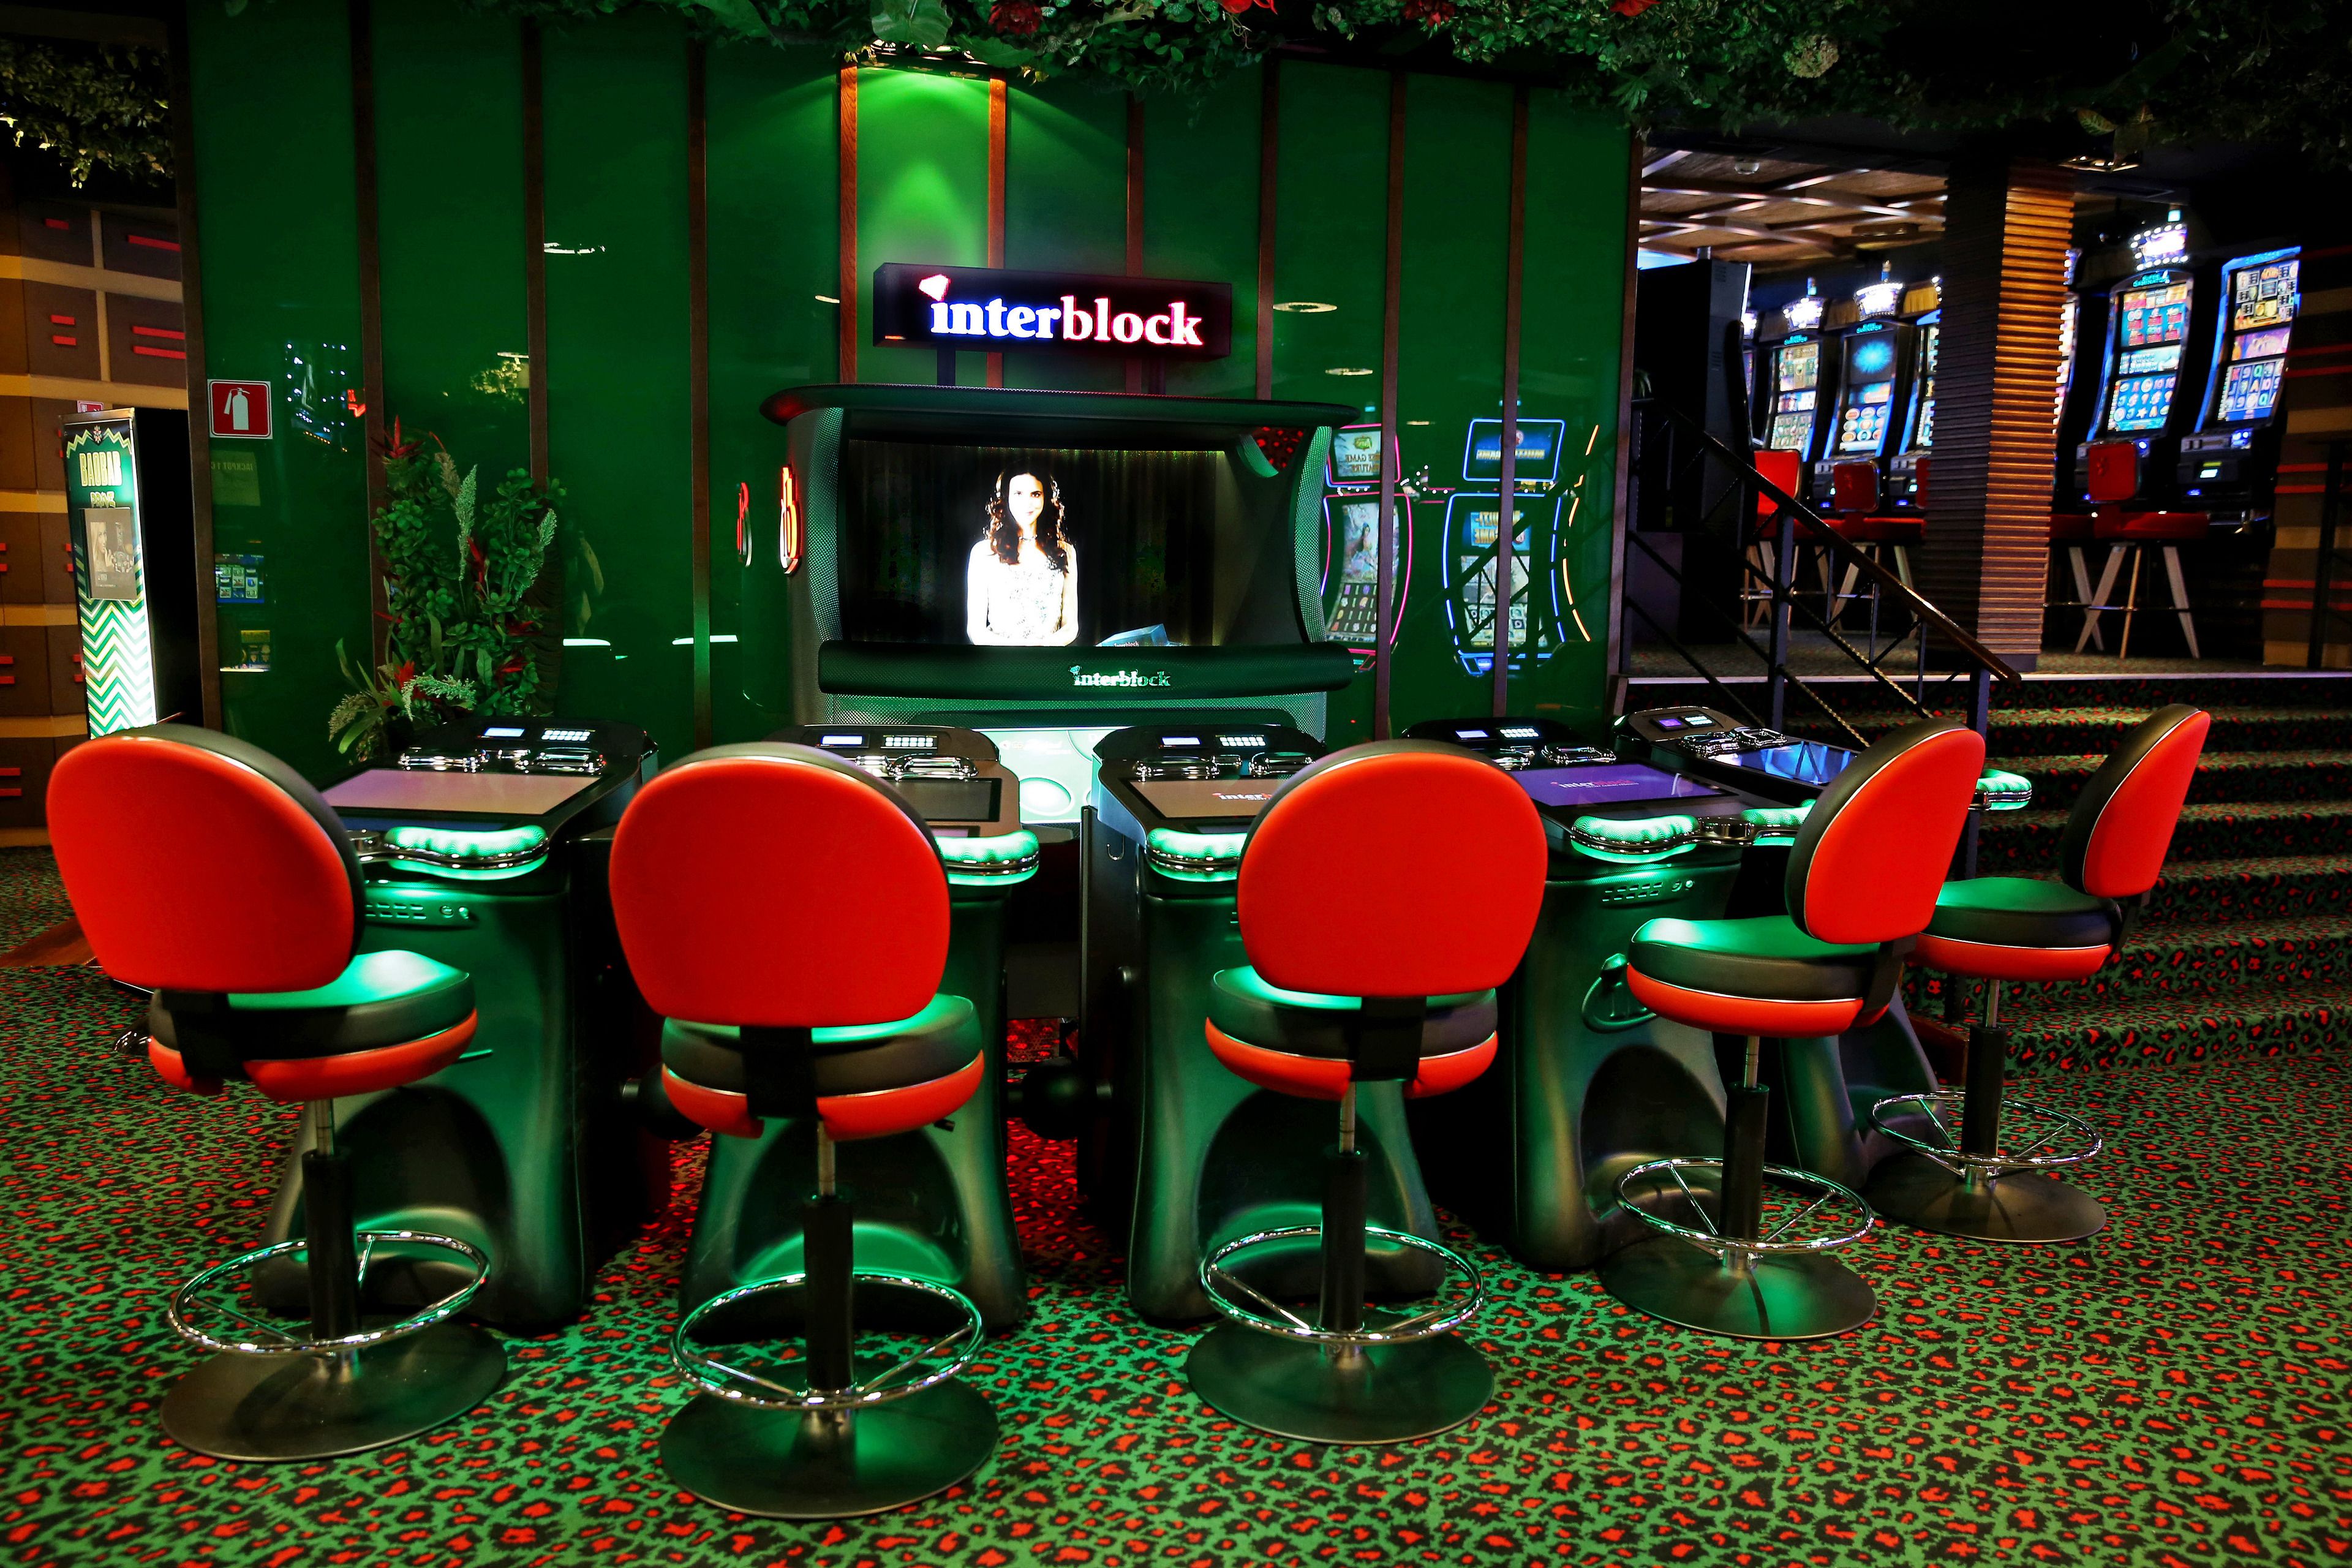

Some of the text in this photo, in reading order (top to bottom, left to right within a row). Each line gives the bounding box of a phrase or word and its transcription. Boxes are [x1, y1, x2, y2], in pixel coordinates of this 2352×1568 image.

[919, 274, 1204, 346] interblock
[79, 450, 123, 487] BAOBAB
[1069, 665, 1171, 687] interblock
